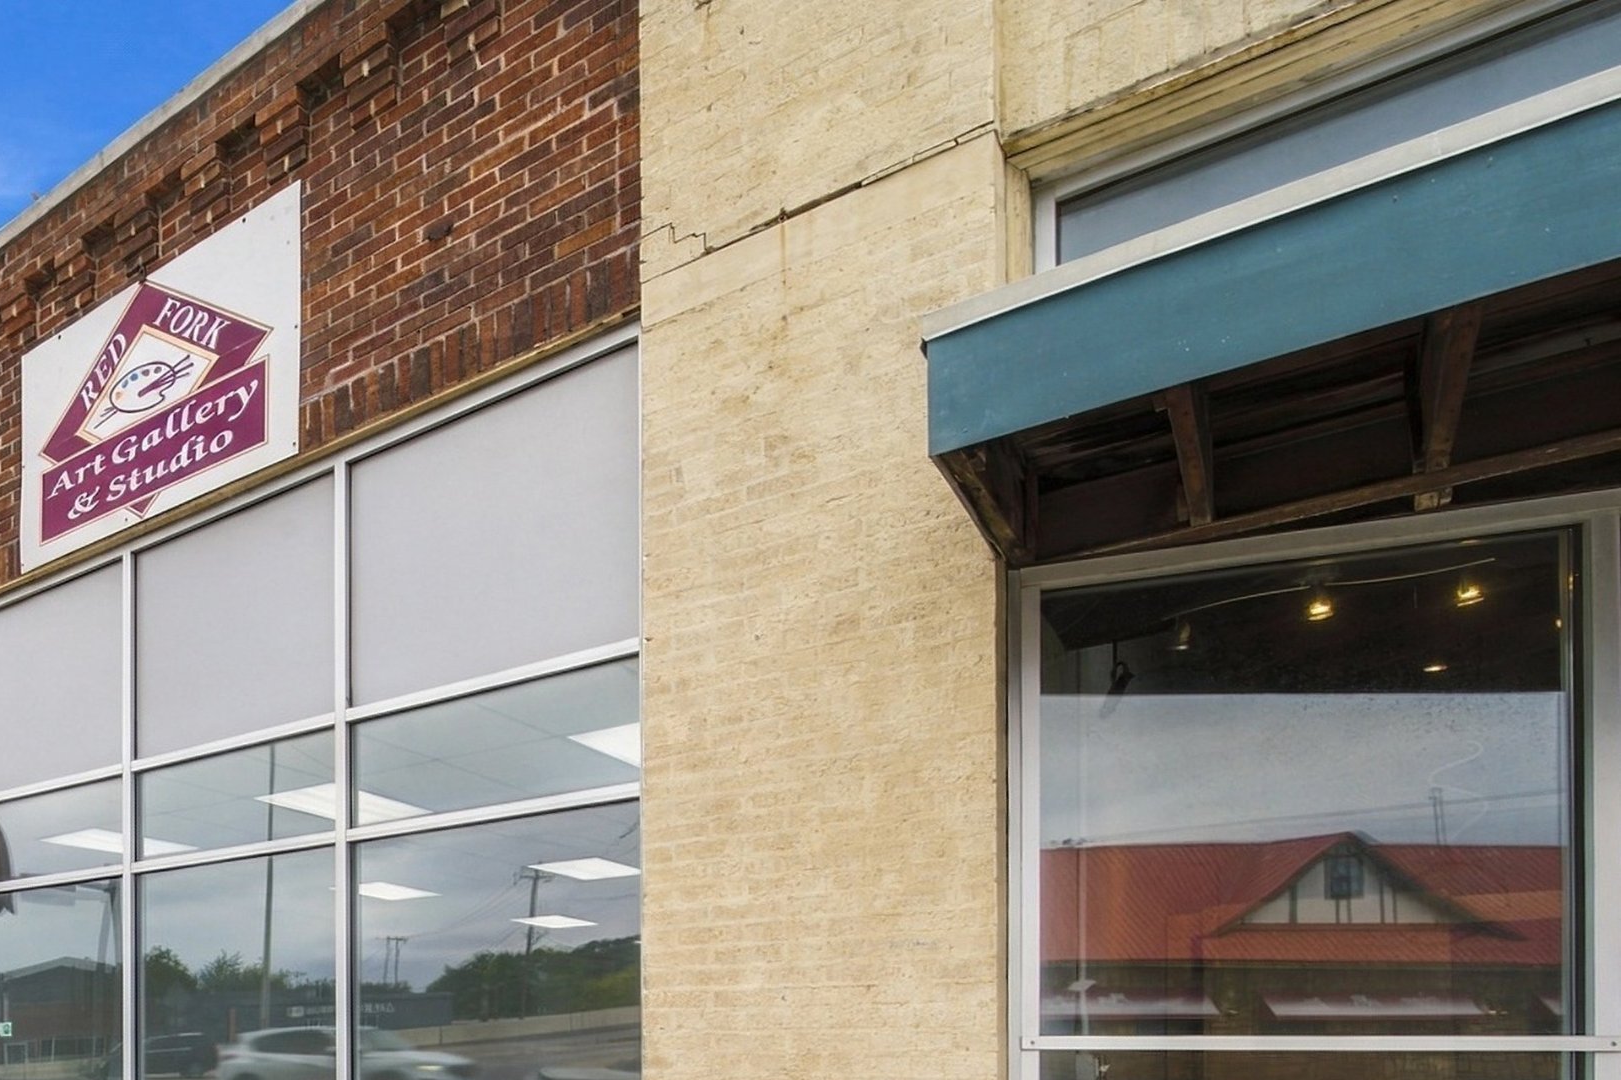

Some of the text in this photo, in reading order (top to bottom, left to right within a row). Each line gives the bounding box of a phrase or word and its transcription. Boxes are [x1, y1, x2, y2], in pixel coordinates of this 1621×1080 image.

[80, 297, 231, 412] RED FORK
[46, 378, 259, 501] Art Gallery
[67, 429, 234, 520] & Studio
